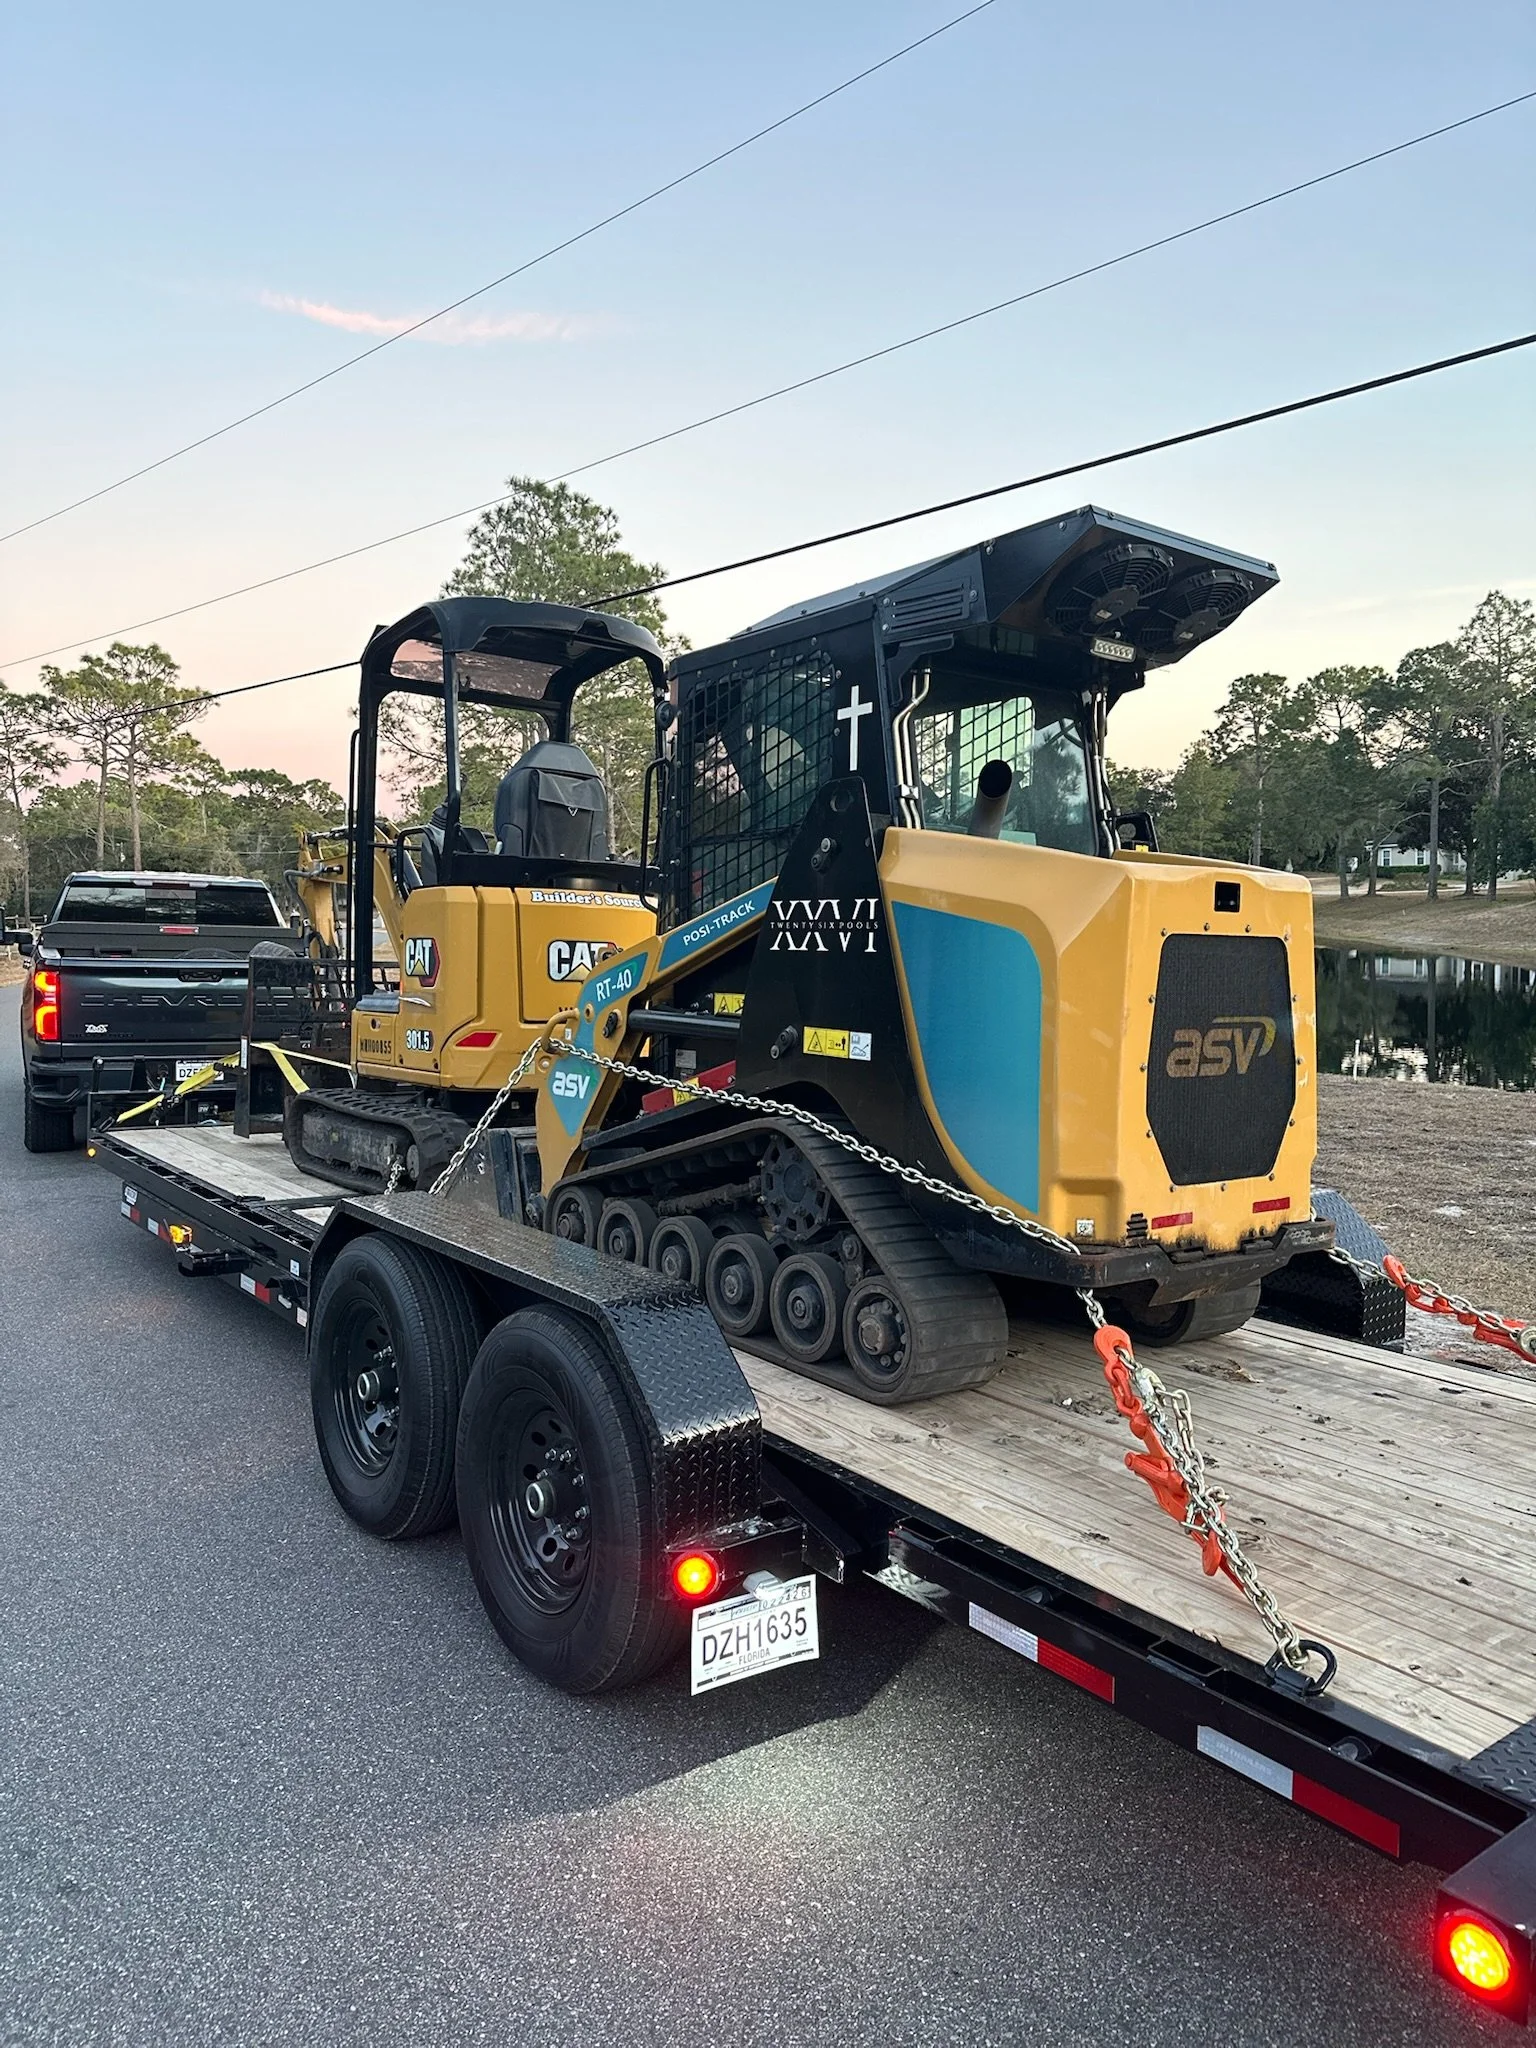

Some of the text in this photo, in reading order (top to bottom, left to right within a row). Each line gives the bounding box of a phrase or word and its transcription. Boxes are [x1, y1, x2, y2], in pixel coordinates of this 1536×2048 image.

[530, 891, 602, 905] Builder's
[683, 900, 756, 947] POSI-TRACK
[770, 921, 879, 930] TWENTY SIX POOLS
[405, 938, 432, 976] CAT
[596, 968, 632, 1002] RT-40
[405, 1029, 431, 1052] 301.5
[703, 1607, 807, 1666] DZH1635
[738, 1647, 771, 1665] FLORIDA
